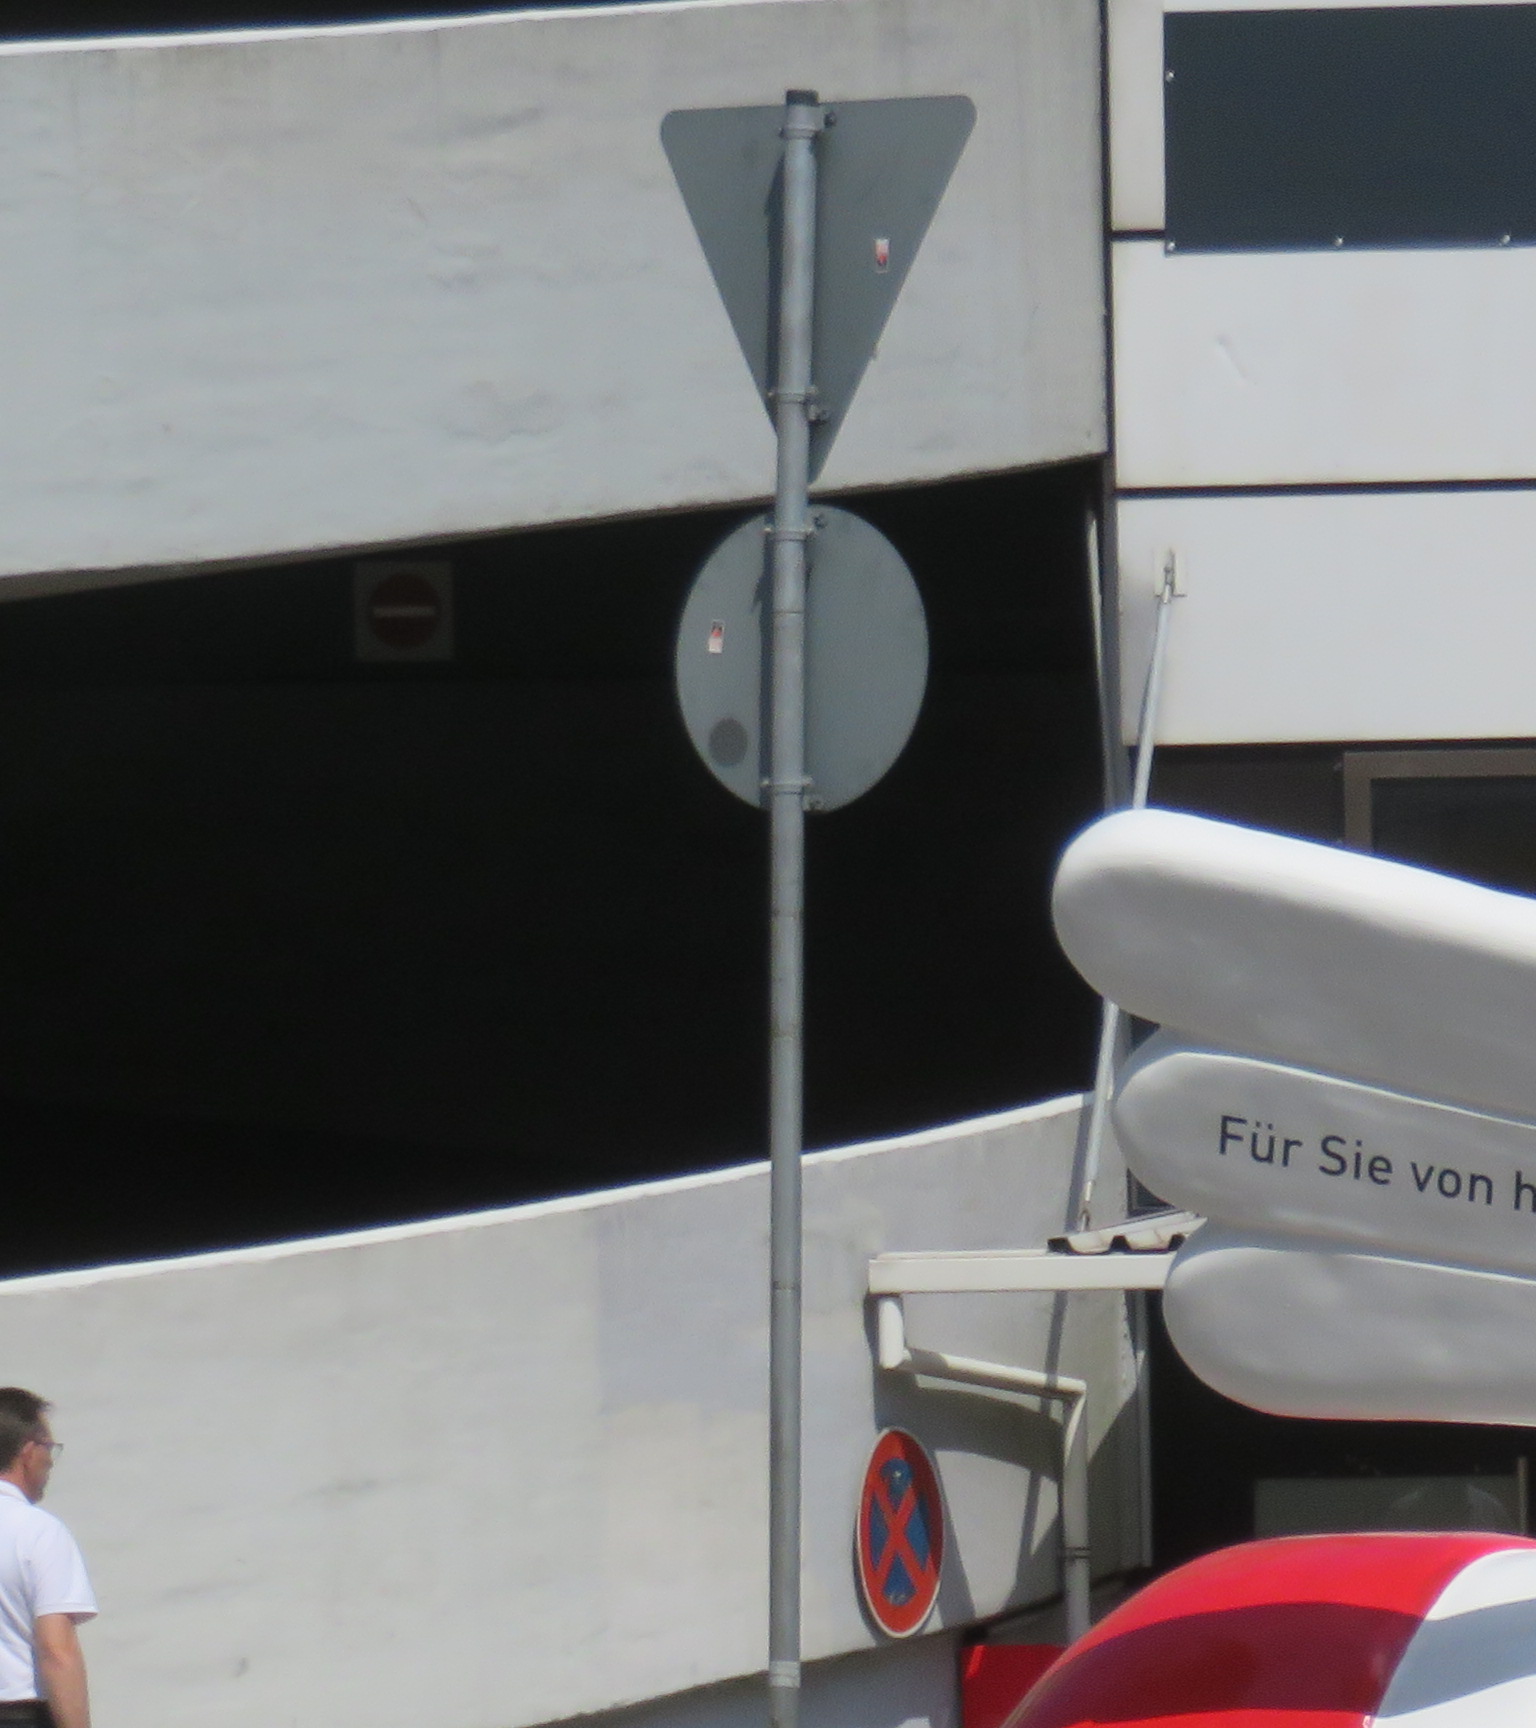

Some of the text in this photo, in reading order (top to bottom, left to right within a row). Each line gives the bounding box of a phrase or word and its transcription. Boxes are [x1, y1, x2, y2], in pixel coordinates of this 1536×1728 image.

[1218, 1114, 1303, 1169] Für
[1318, 1135, 1394, 1187] Sie
[1411, 1160, 1494, 1205] von
